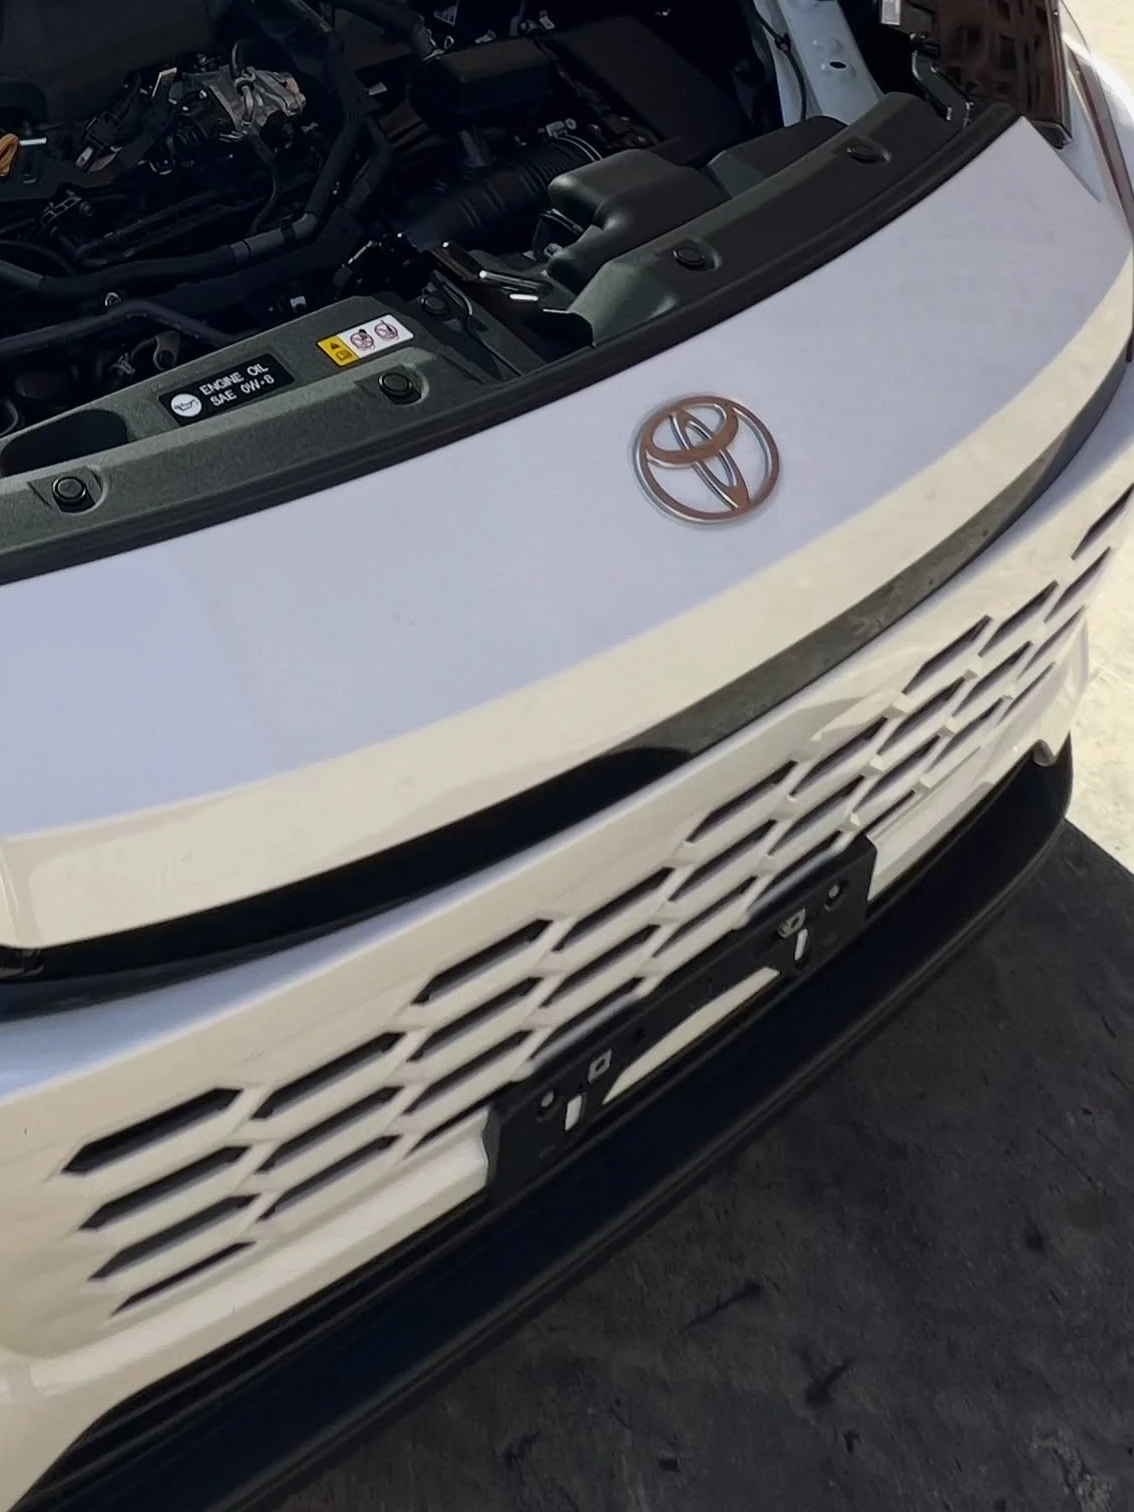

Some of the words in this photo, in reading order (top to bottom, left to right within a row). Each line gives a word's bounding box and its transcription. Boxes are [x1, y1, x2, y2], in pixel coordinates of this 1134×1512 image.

[199, 371, 245, 396] ENGINE
[246, 363, 269, 377] OIL
[210, 390, 238, 407] SAE
